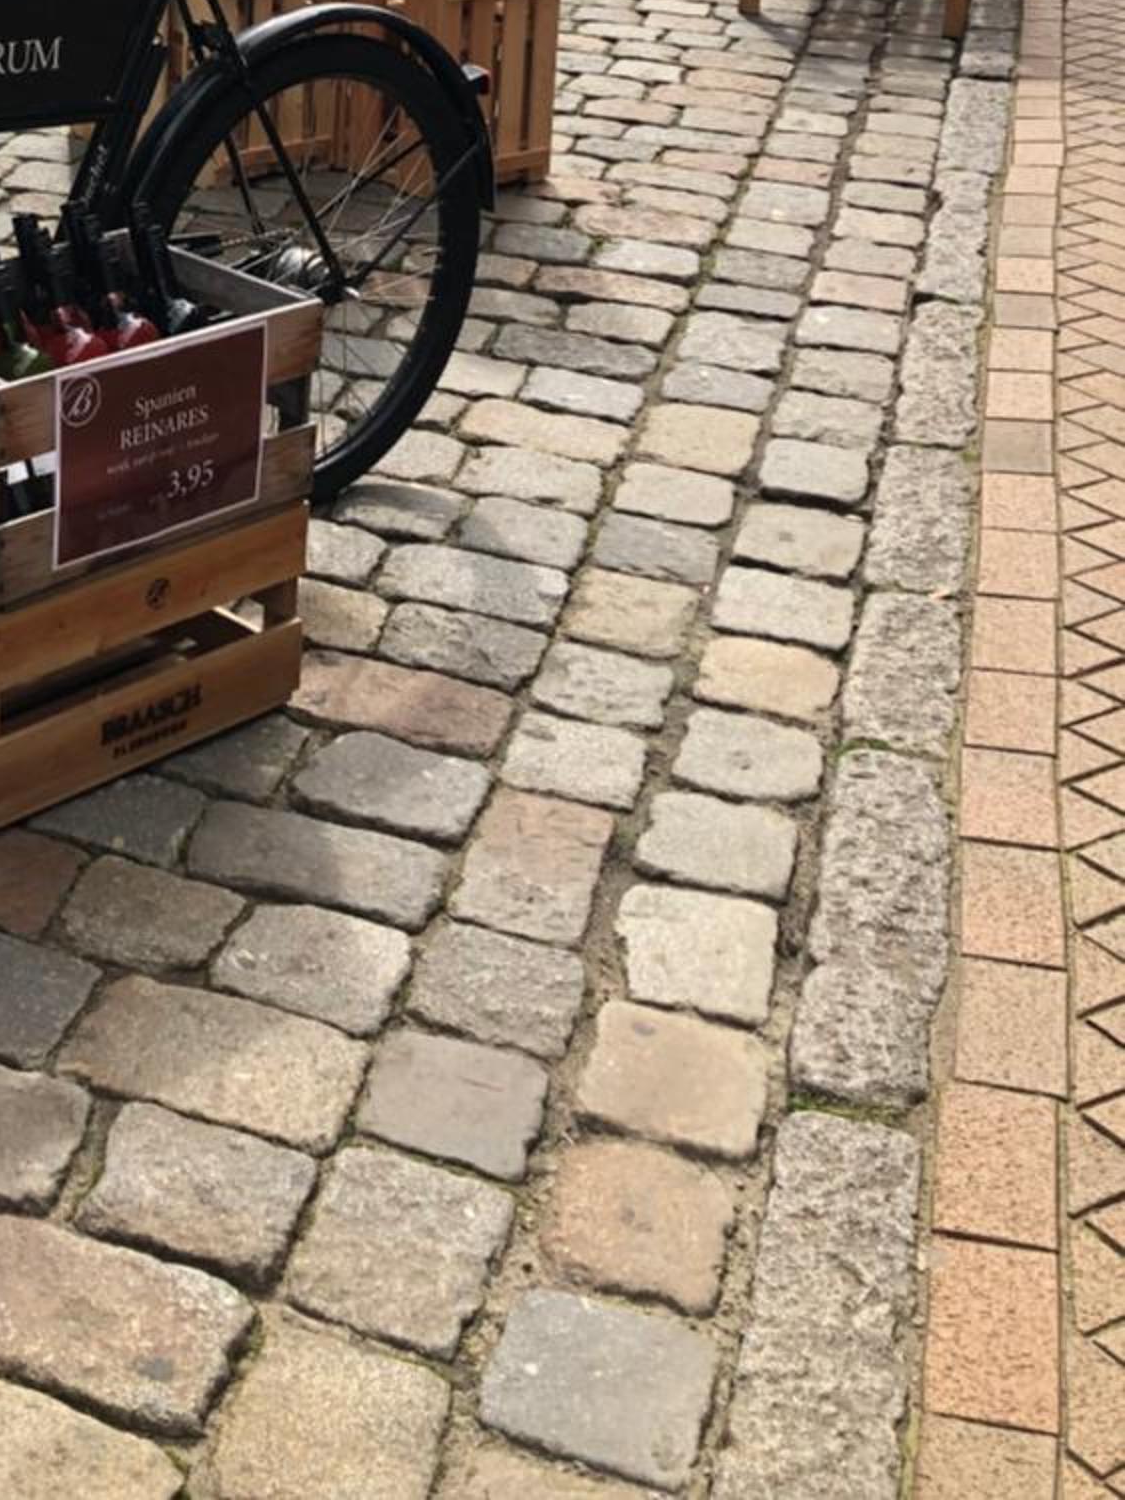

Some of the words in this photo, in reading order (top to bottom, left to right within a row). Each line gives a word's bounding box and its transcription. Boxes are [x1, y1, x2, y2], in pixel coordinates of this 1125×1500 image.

[133, 384, 198, 421] Spanien
[119, 404, 210, 451] REINARES
[167, 459, 215, 499] 3,95
